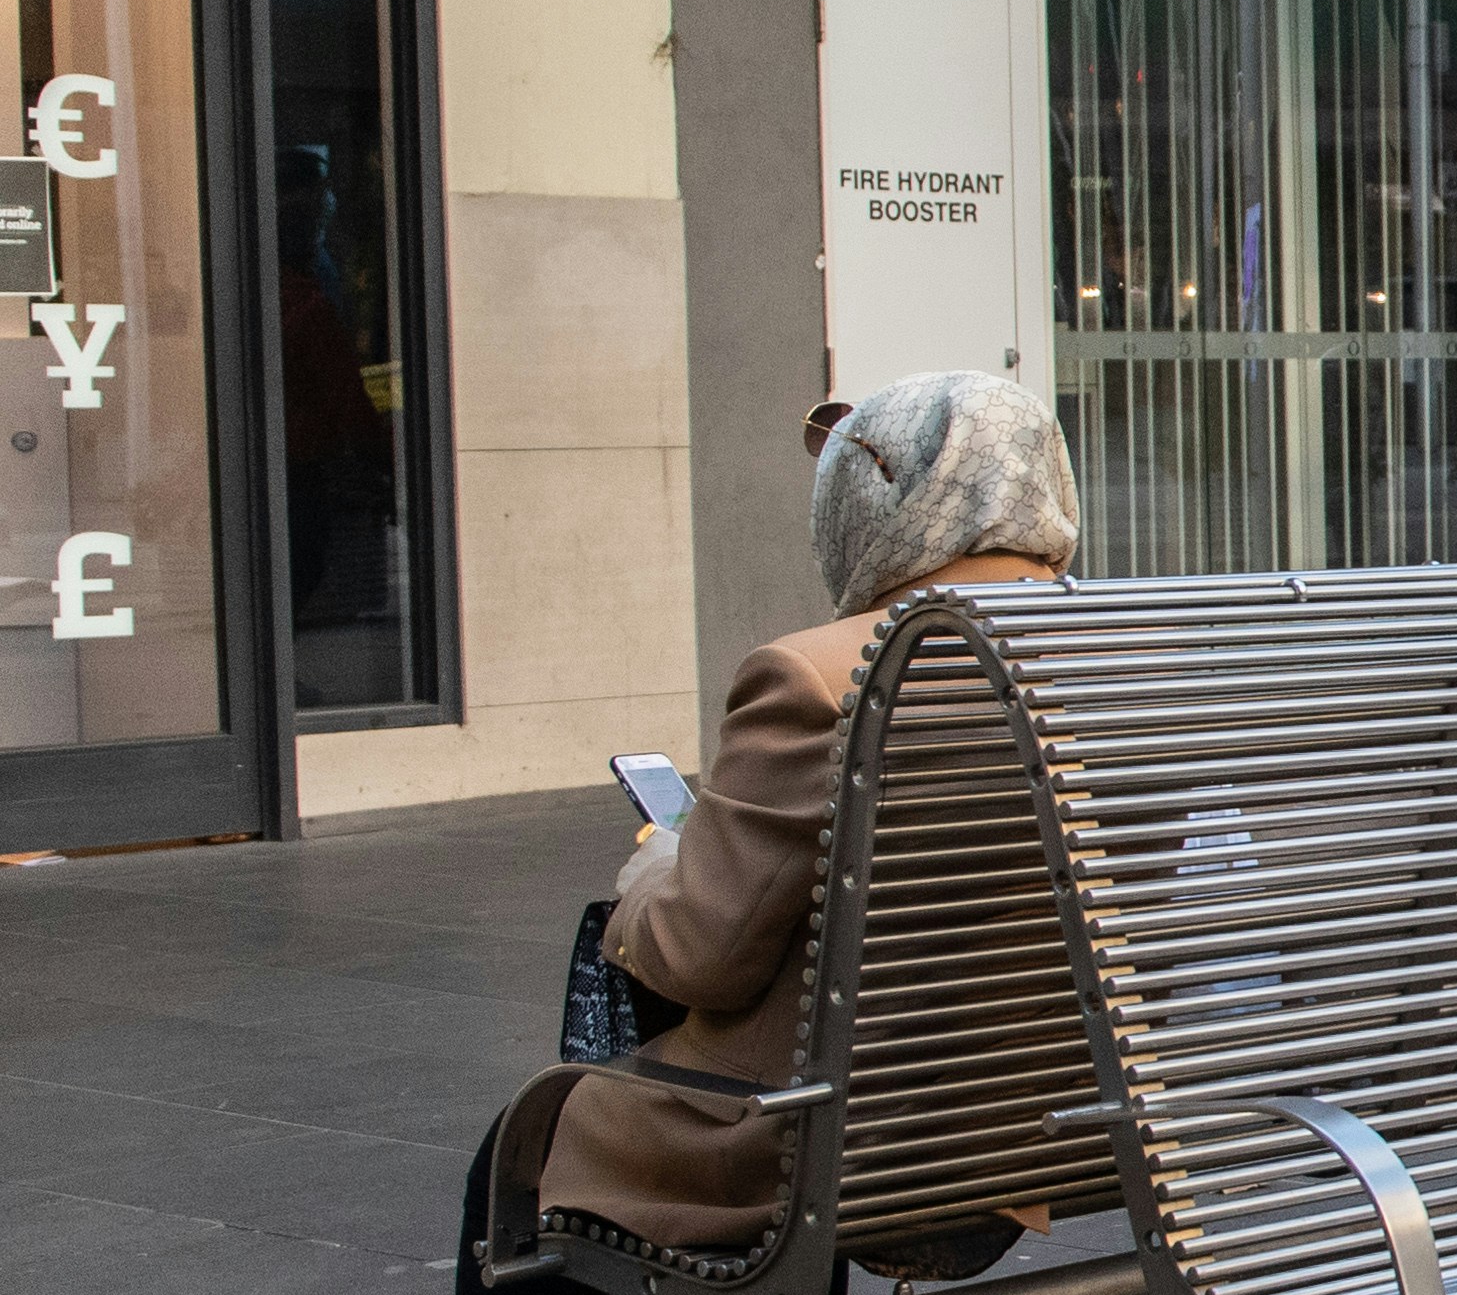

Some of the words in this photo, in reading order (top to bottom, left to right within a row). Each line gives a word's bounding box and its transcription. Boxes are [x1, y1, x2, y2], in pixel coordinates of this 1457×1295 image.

[28, 74, 119, 179] €
[839, 168, 890, 191] FIRE
[897, 171, 1004, 195] HYDRANT
[869, 200, 978, 223] BOOSTER
[31, 303, 127, 410] ¥
[50, 531, 135, 640] £
